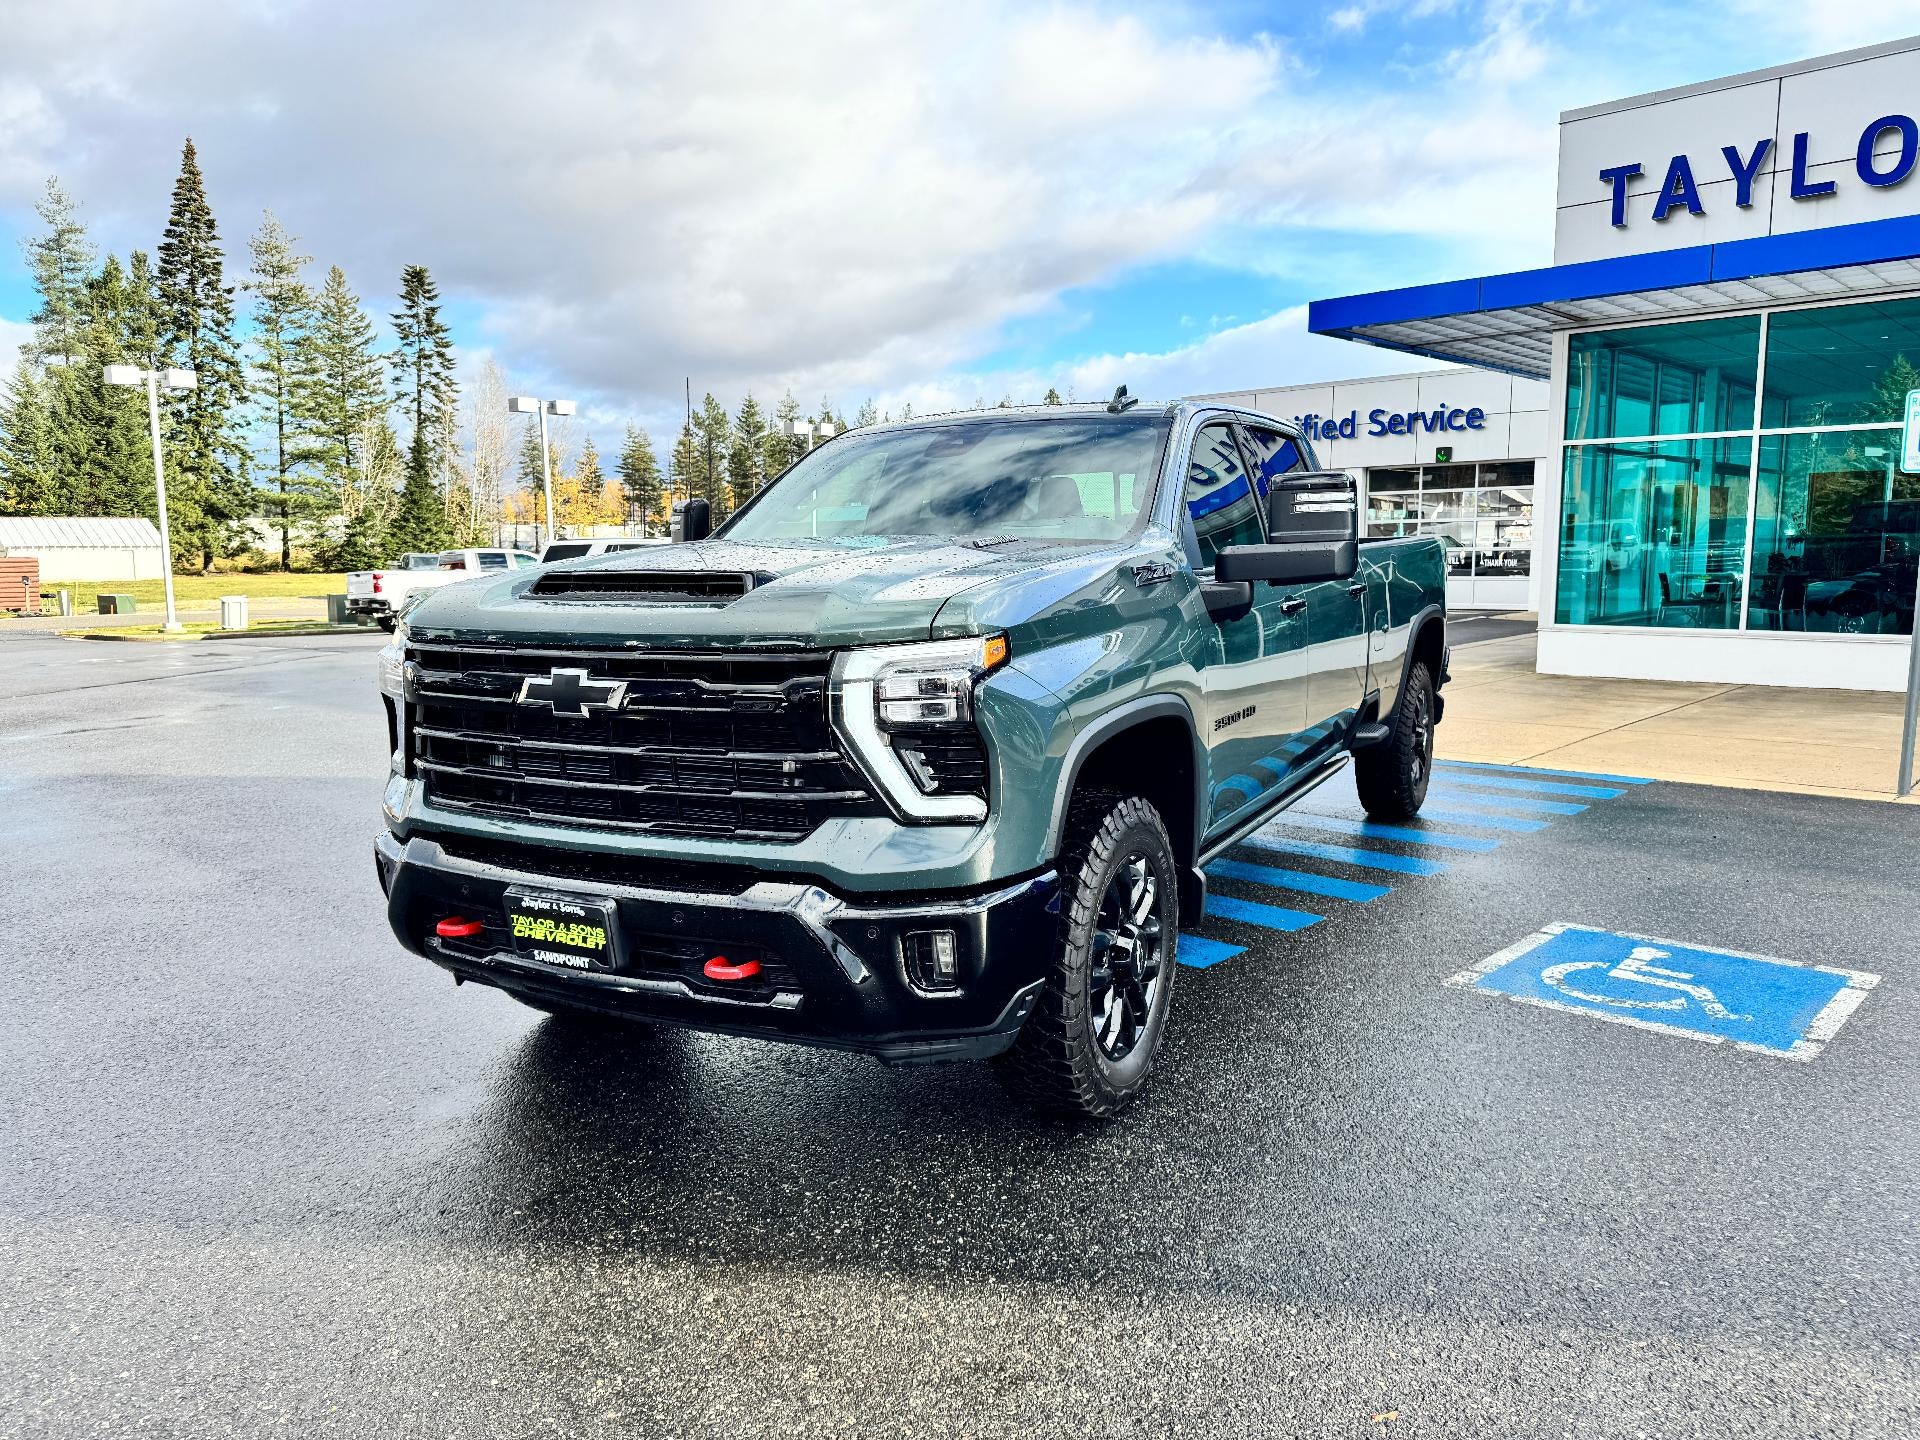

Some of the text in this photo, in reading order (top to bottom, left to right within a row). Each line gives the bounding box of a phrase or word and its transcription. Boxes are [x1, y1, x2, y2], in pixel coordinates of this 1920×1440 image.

[1599, 114, 1919, 229] TAYLO
[1368, 402, 1487, 437] Service
[511, 914, 605, 938] TAYLOR & SONS
[513, 925, 607, 950] CHEVROLET
[533, 949, 590, 968] SANDPOINT
